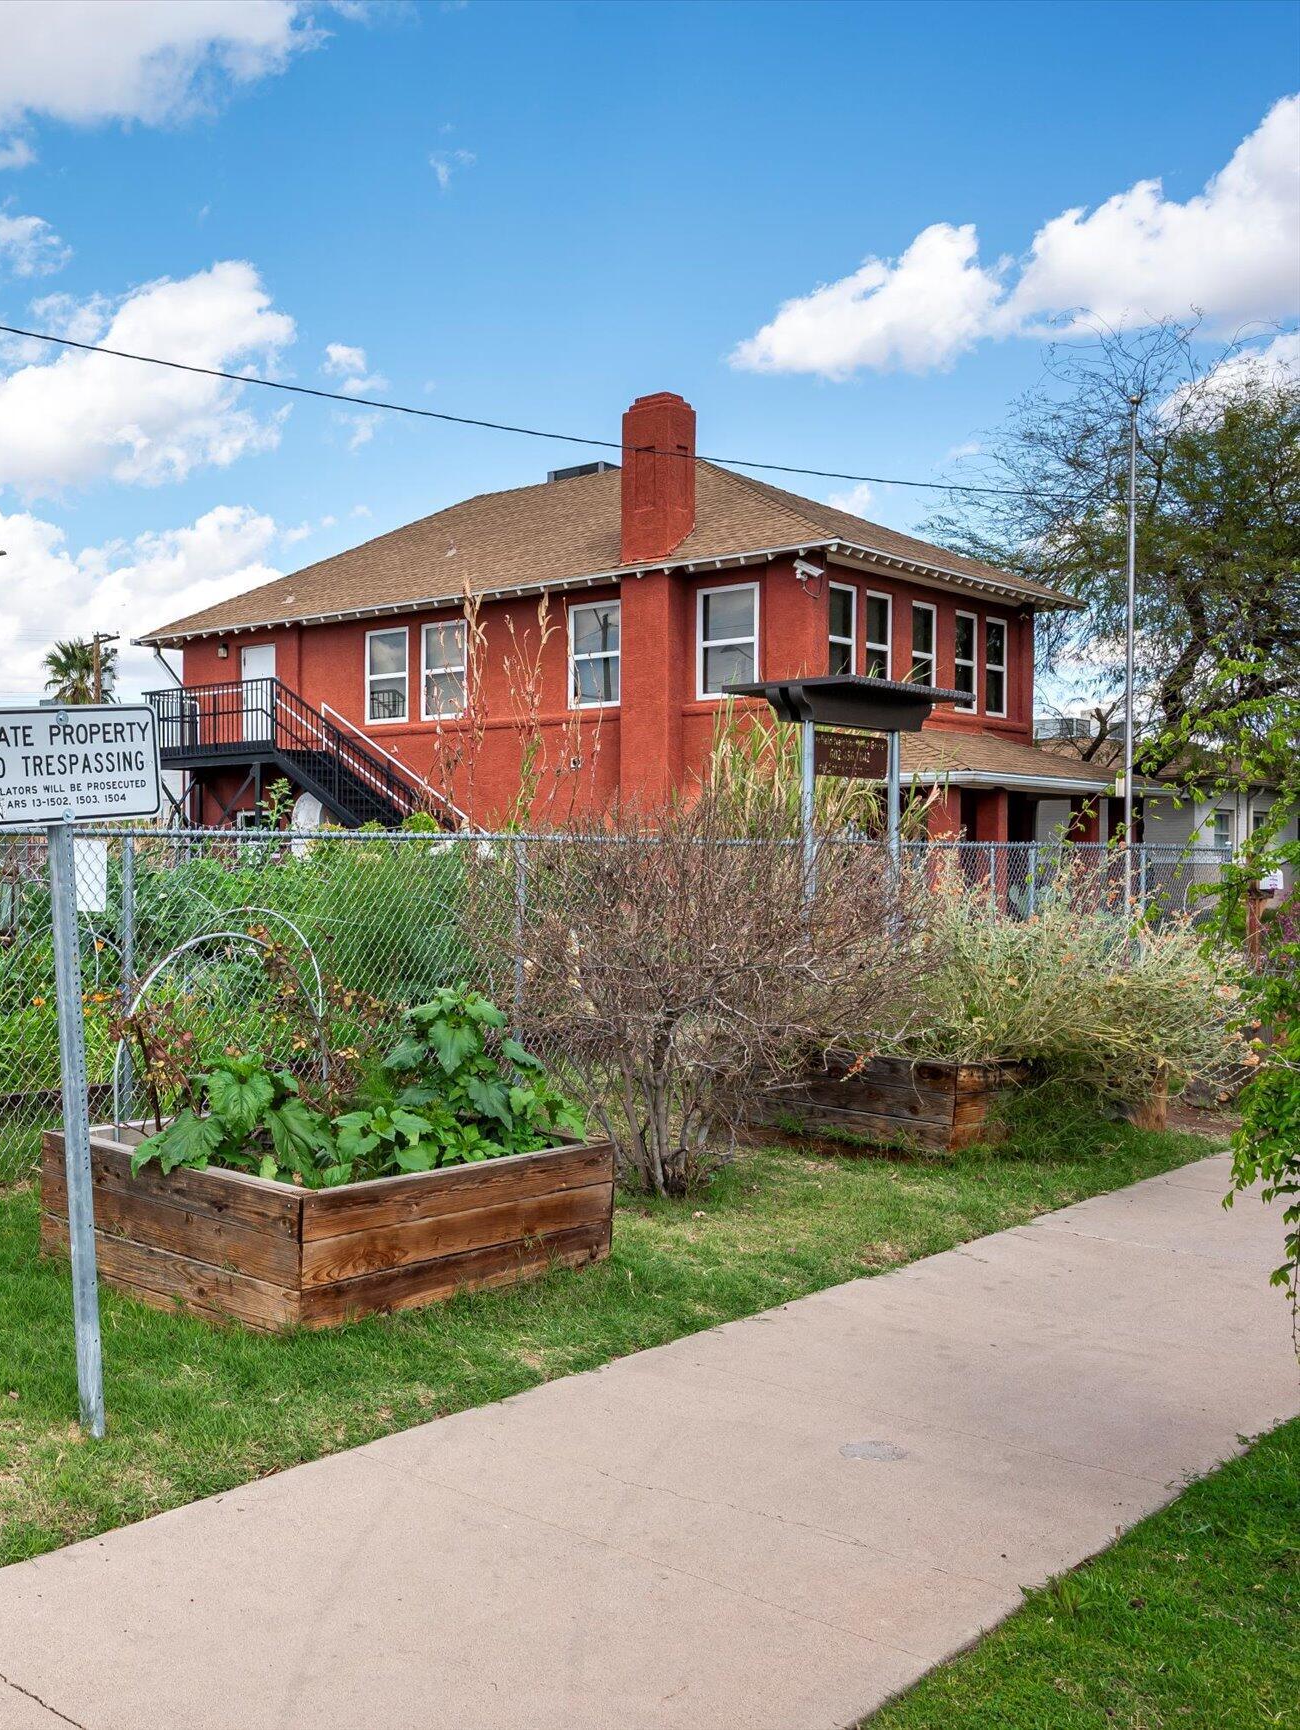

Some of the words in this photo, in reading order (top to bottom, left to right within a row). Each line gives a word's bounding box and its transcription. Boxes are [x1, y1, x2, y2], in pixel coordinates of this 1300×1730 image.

[49, 721, 150, 746] PROPERTY
[21, 750, 145, 777] TRESPASSING
[43, 783, 65, 793] WILL
[70, 783, 82, 792] BE
[87, 779, 147, 791] PROSECUTED
[7, 799, 27, 809] ARS
[104, 793, 127, 803] 1504
